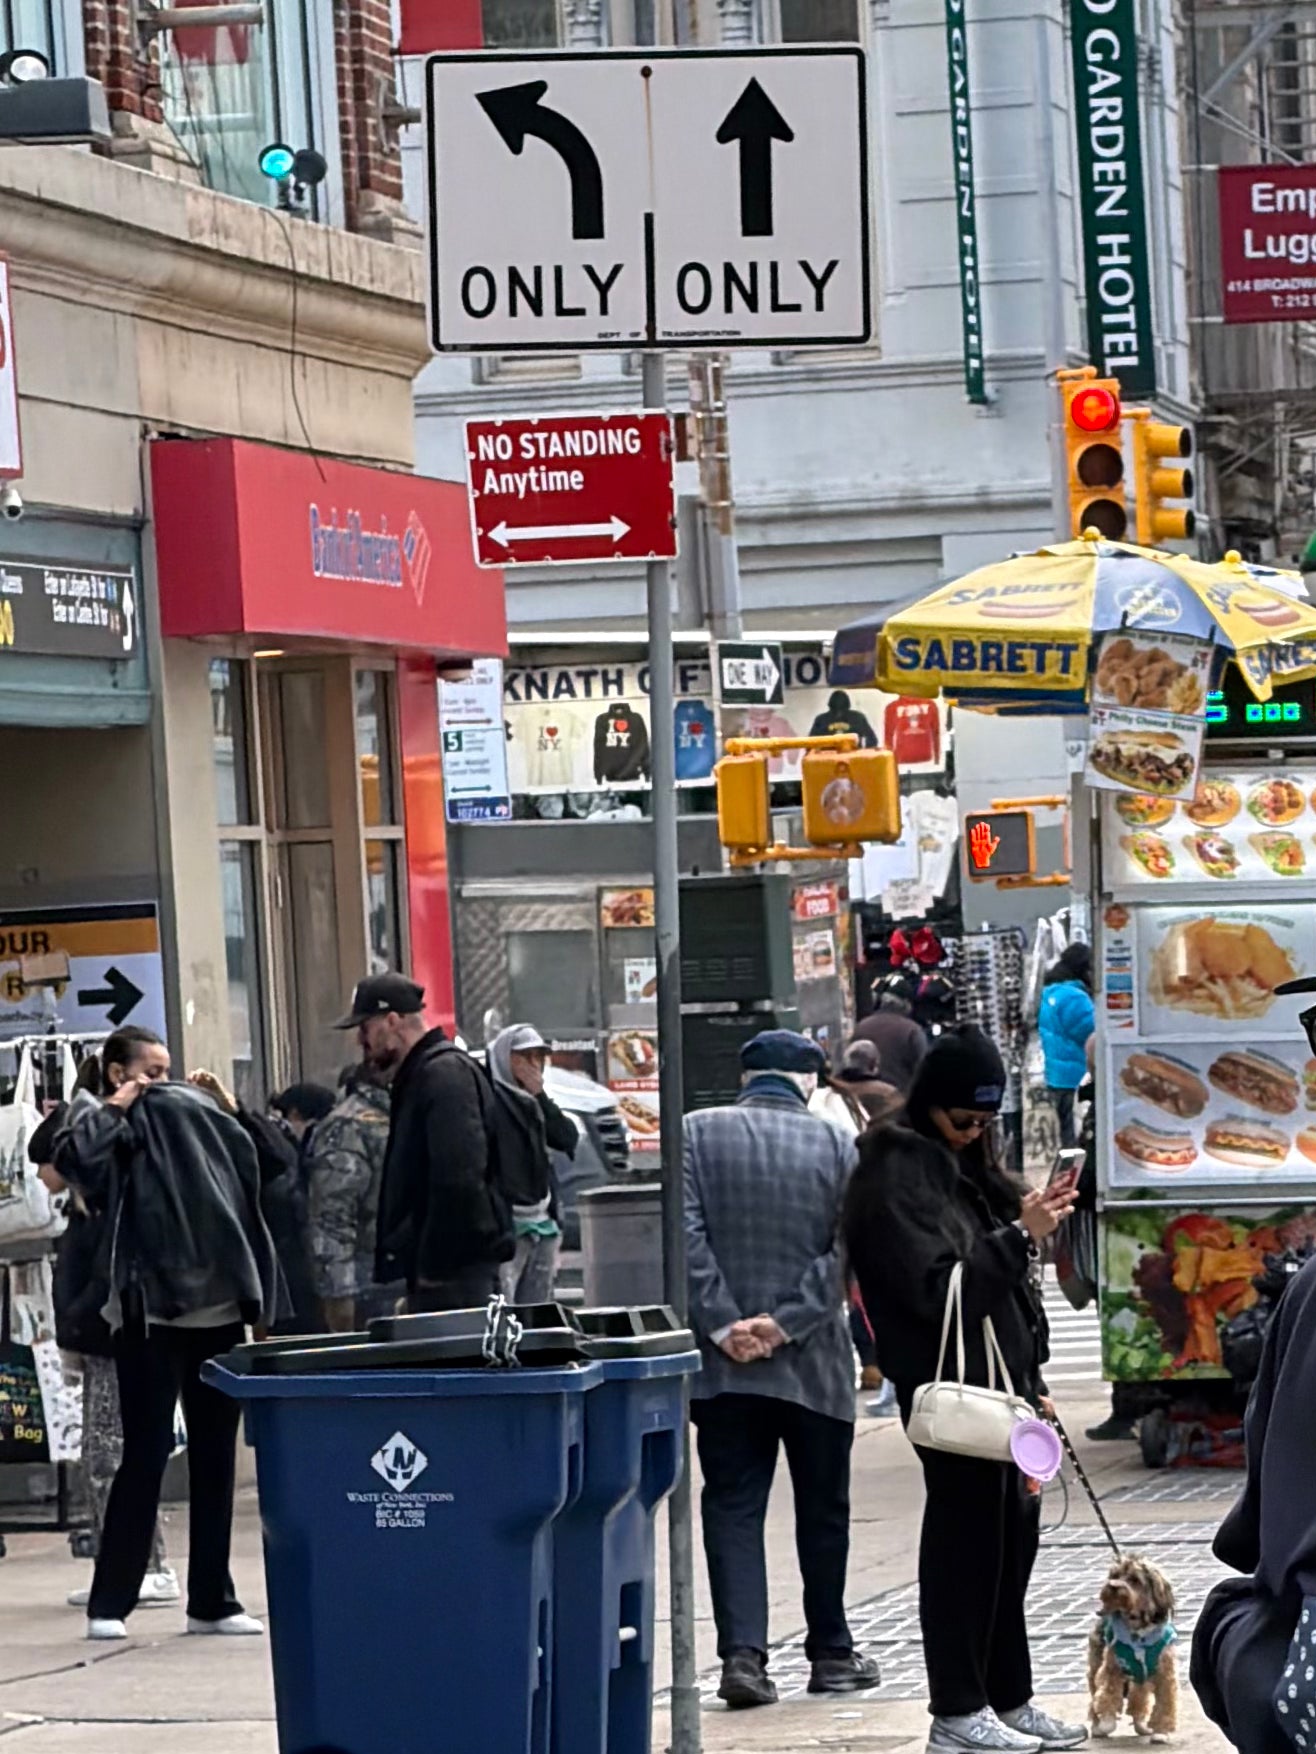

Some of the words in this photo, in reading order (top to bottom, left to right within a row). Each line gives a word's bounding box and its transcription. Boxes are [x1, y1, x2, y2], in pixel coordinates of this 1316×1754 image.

[1085, 28, 1129, 217] GARDEN
[461, 263, 625, 319] ONLY
[676, 259, 840, 315] ONLY
[1227, 280, 1251, 293] 414
[1096, 233, 1139, 377] HOTEL
[1286, 294, 1310, 307] 212
[661, 329, 742, 338] TRANSPORTATION
[478, 434, 513, 461] NO
[520, 427, 641, 459] STANDING
[483, 465, 584, 499] Anytime
[895, 636, 1078, 676] SABRETT
[728, 662, 747, 686] ONE
[754, 662, 773, 687] WAY
[447, 733, 459, 751] 5
[537, 739, 562, 751] NY
[606, 732, 631, 748] NY
[679, 732, 706, 748] NY
[14, 1425, 43, 1443] Bag
[347, 1492, 379, 1502] WASTE
[382, 1492, 455, 1502] CONNECTIONS
